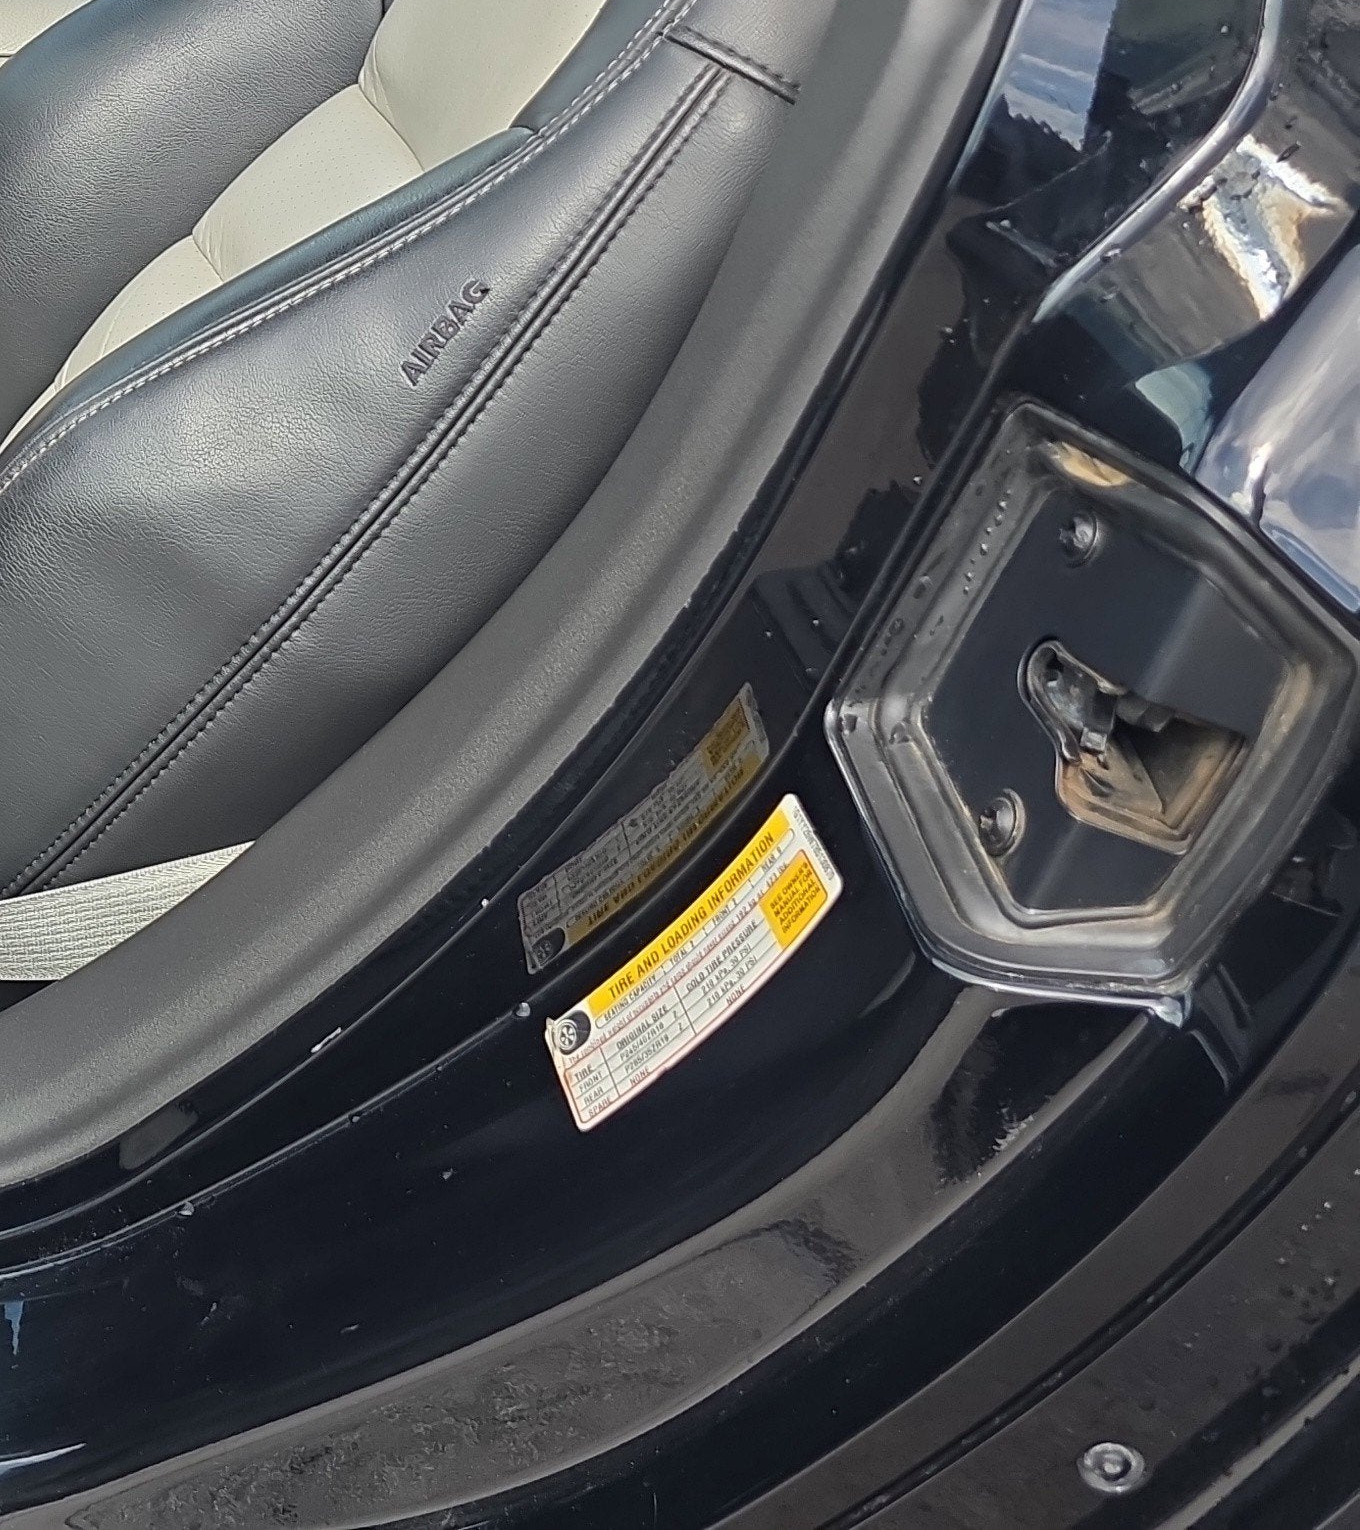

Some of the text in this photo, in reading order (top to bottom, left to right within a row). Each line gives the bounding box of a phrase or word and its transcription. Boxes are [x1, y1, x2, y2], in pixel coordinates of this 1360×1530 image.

[400, 279, 490, 388] AIRBAG
[607, 975, 636, 999] TIRE
[635, 952, 661, 976] AND
[660, 905, 708, 954] LOADING
[707, 832, 775, 910] INFORMATION
[770, 894, 782, 909] SEE
[773, 887, 799, 918] MANUAL
[799, 869, 814, 889] FOR
[779, 880, 817, 925] ADDITIONAL
[781, 886, 822, 934] INFORMATION
[574, 920, 758, 1083] TIRE ORIGINAL SIZE COLD TIRE PRESSURE
[588, 983, 747, 1117] SPARE NONE NONE
[579, 1071, 604, 1092] FRONT
[583, 1087, 605, 1105] REAR
